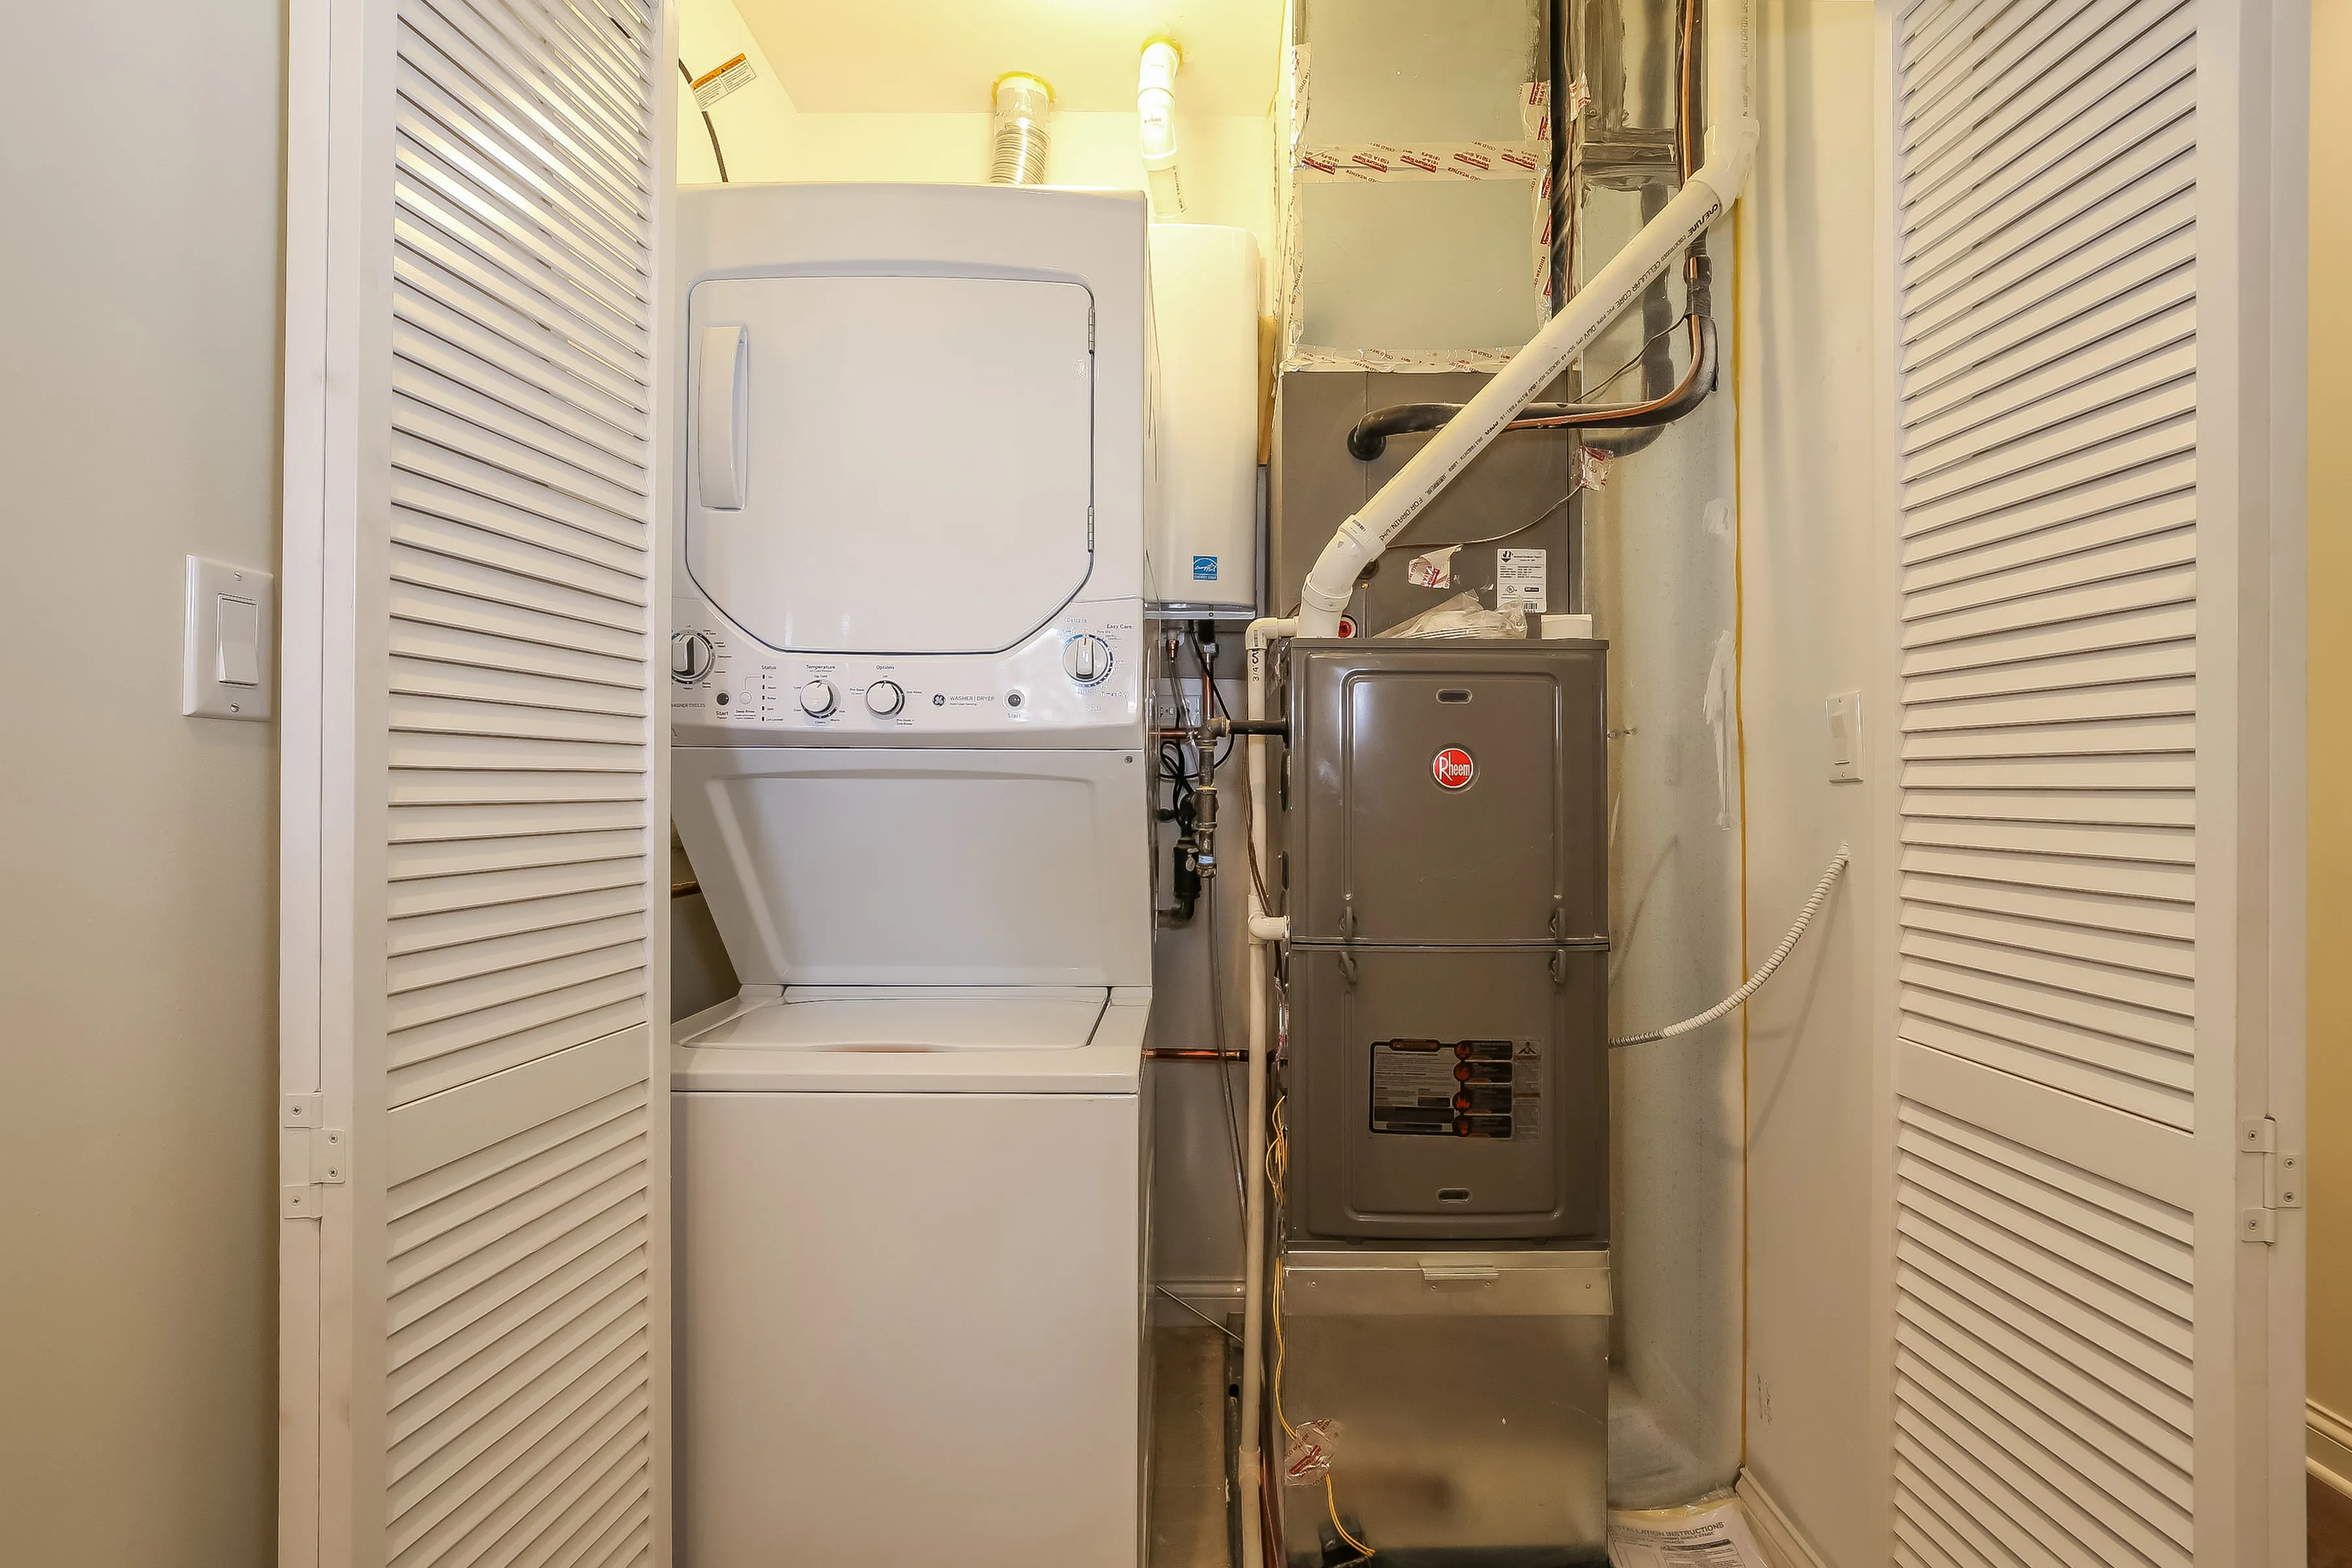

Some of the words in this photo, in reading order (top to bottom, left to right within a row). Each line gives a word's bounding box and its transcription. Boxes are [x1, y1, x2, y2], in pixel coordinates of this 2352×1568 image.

[1482, 142, 1496, 151] COLD
[1346, 169, 1367, 180] WEATHER
[1446, 167, 1469, 178] WEATHER
[1536, 256, 1546, 278] WEATHER
[1629, 260, 1662, 291] CELLULAR
[1613, 289, 1633, 308] CORE
[1581, 324, 1597, 340] DWV
[1409, 496, 1424, 511] FOR
[1439, 751, 1470, 781] Rheem
[1665, 1522, 1725, 1537] INSTRUCTIONS
